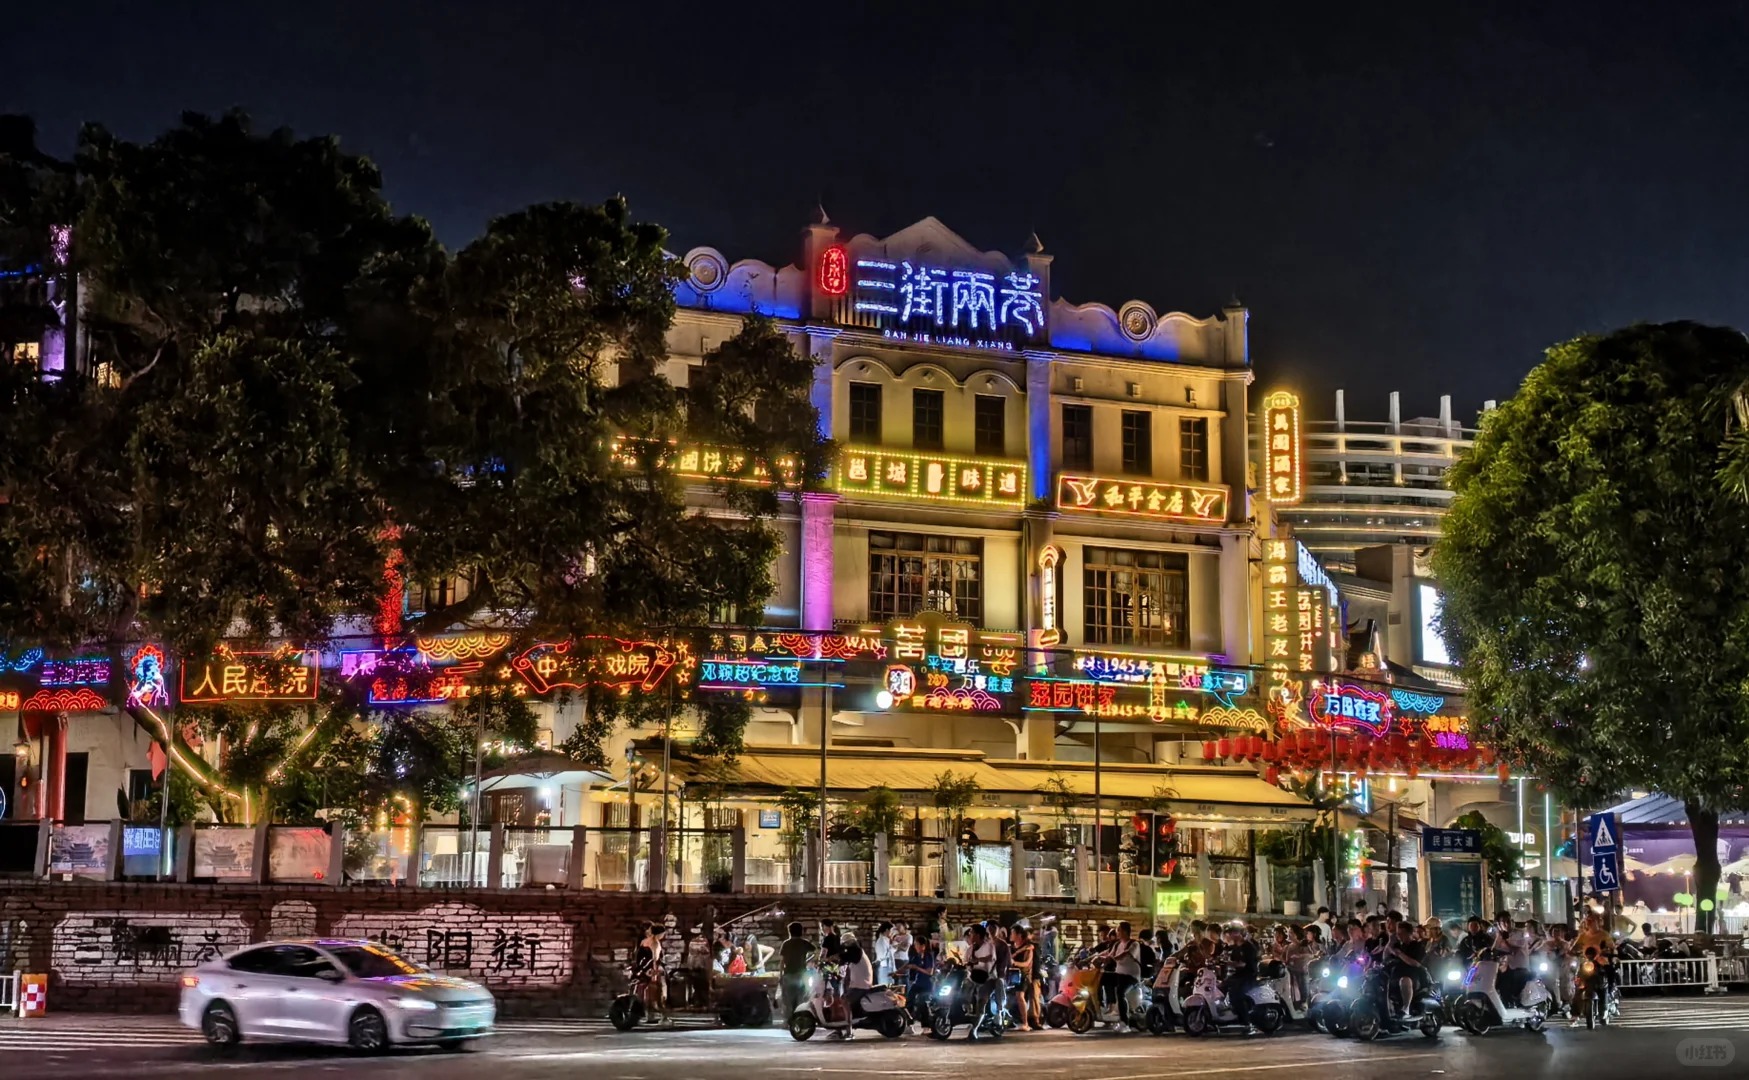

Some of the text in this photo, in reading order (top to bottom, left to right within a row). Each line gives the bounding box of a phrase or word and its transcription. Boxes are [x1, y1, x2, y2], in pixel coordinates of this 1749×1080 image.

[913, 333, 930, 343] JIE
[977, 340, 1013, 350] XIANG
[538, 655, 649, 678] 中戏院
[1030, 680, 1117, 707] 荔园饼家
